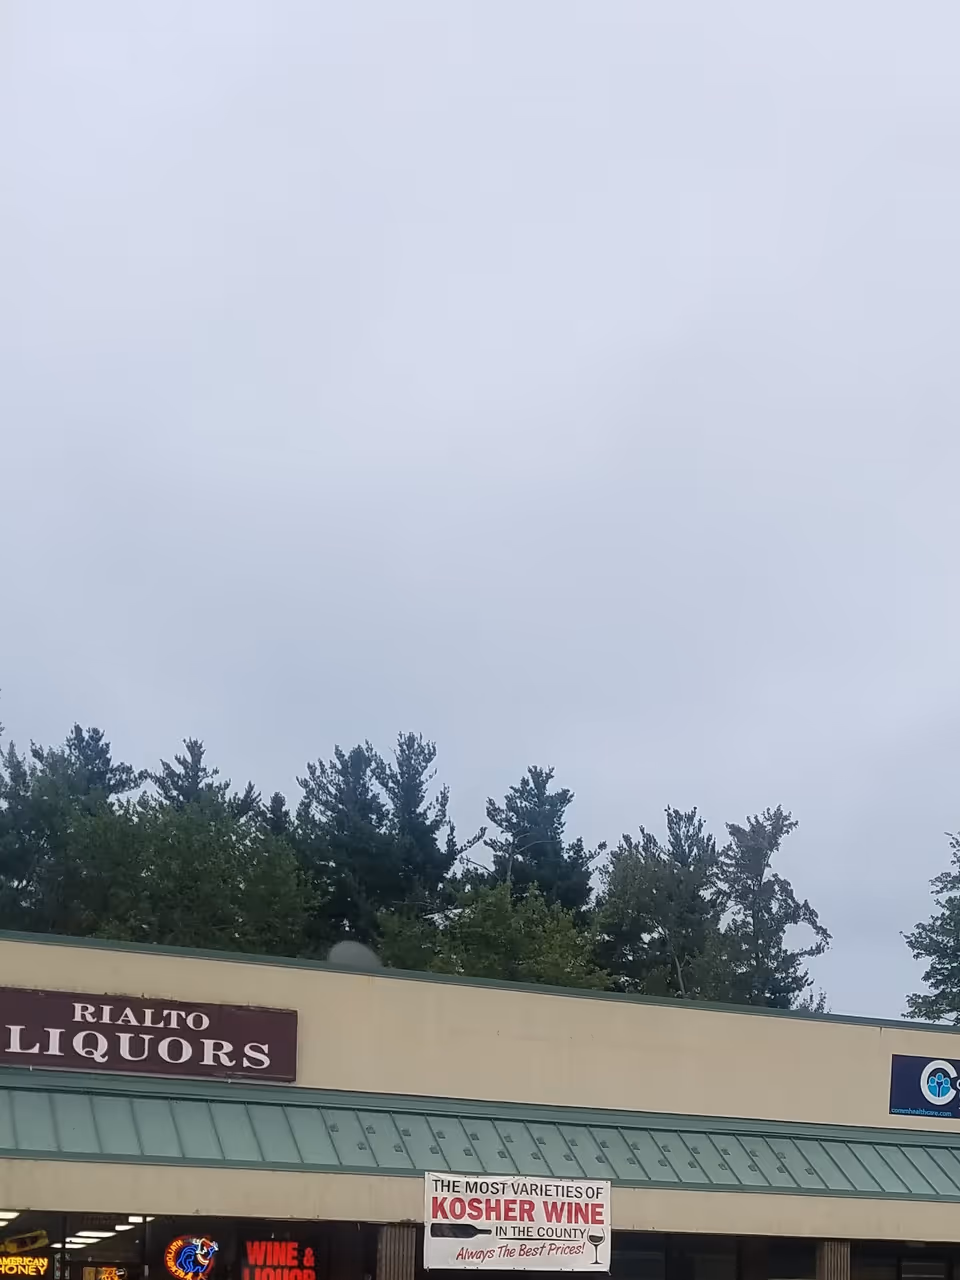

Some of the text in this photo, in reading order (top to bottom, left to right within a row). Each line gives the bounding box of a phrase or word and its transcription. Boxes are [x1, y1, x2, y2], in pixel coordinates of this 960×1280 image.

[72, 1002, 210, 1031] RIALTO
[4, 1024, 271, 1069] LIQUORS
[431, 1179, 604, 1200] THE MOST VARIETIES OF
[431, 1196, 605, 1225] KOSHER WINE
[495, 1226, 587, 1239] IN THE COUNTY
[246, 1240, 315, 1267] WINE &
[456, 1242, 586, 1263] Always The Best Prices!
